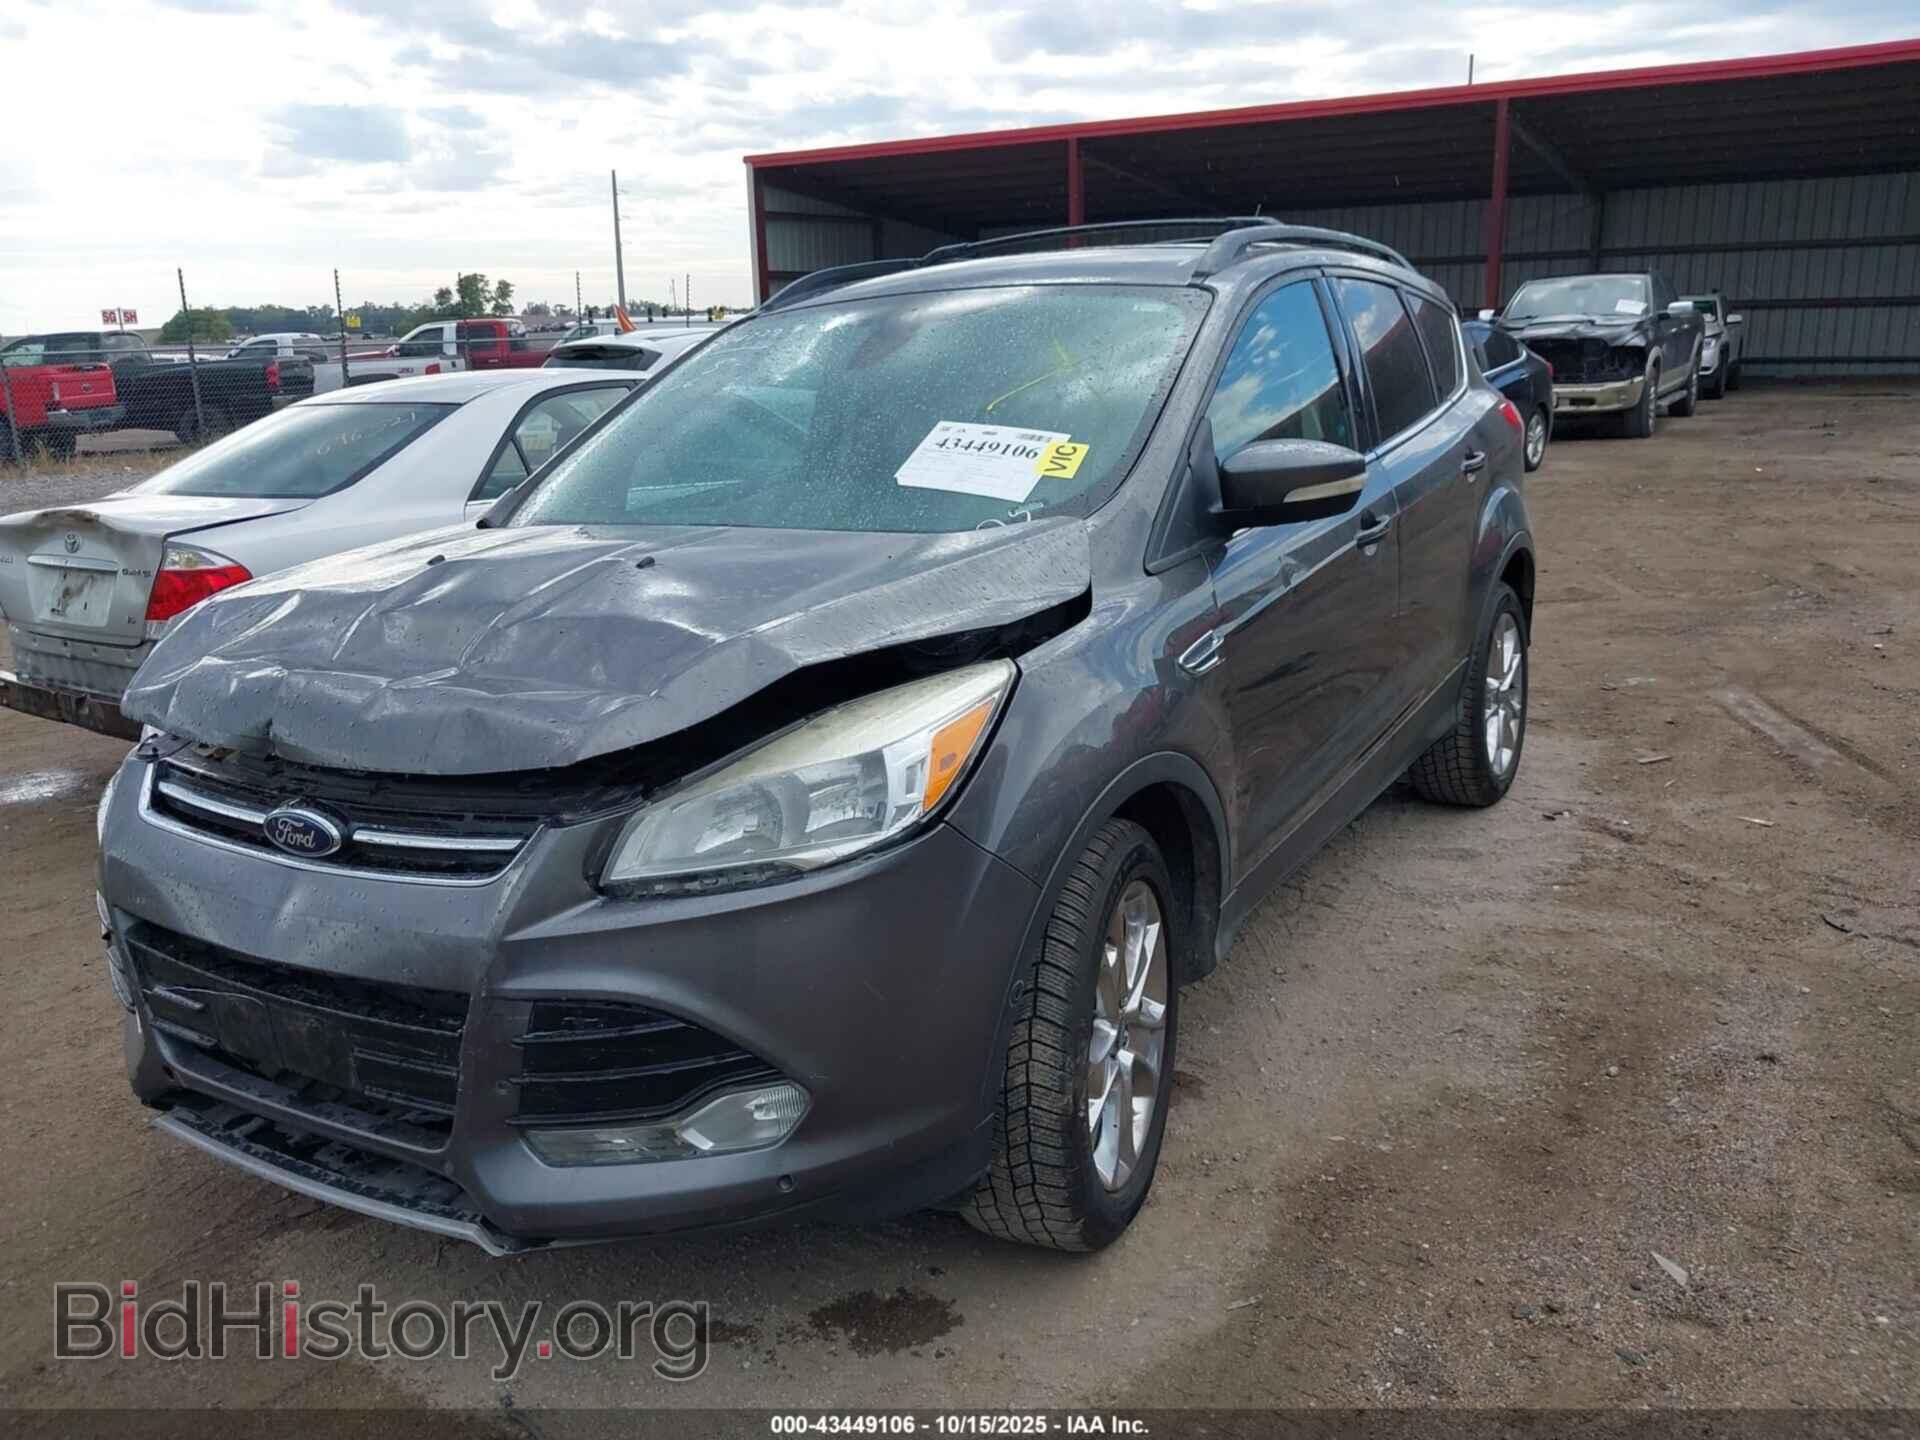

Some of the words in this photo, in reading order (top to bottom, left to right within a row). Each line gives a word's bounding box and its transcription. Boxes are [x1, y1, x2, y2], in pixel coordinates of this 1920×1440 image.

[936, 437, 1040, 459] 43449106
[1045, 445, 1077, 473] VIC
[275, 818, 316, 848] Ford
